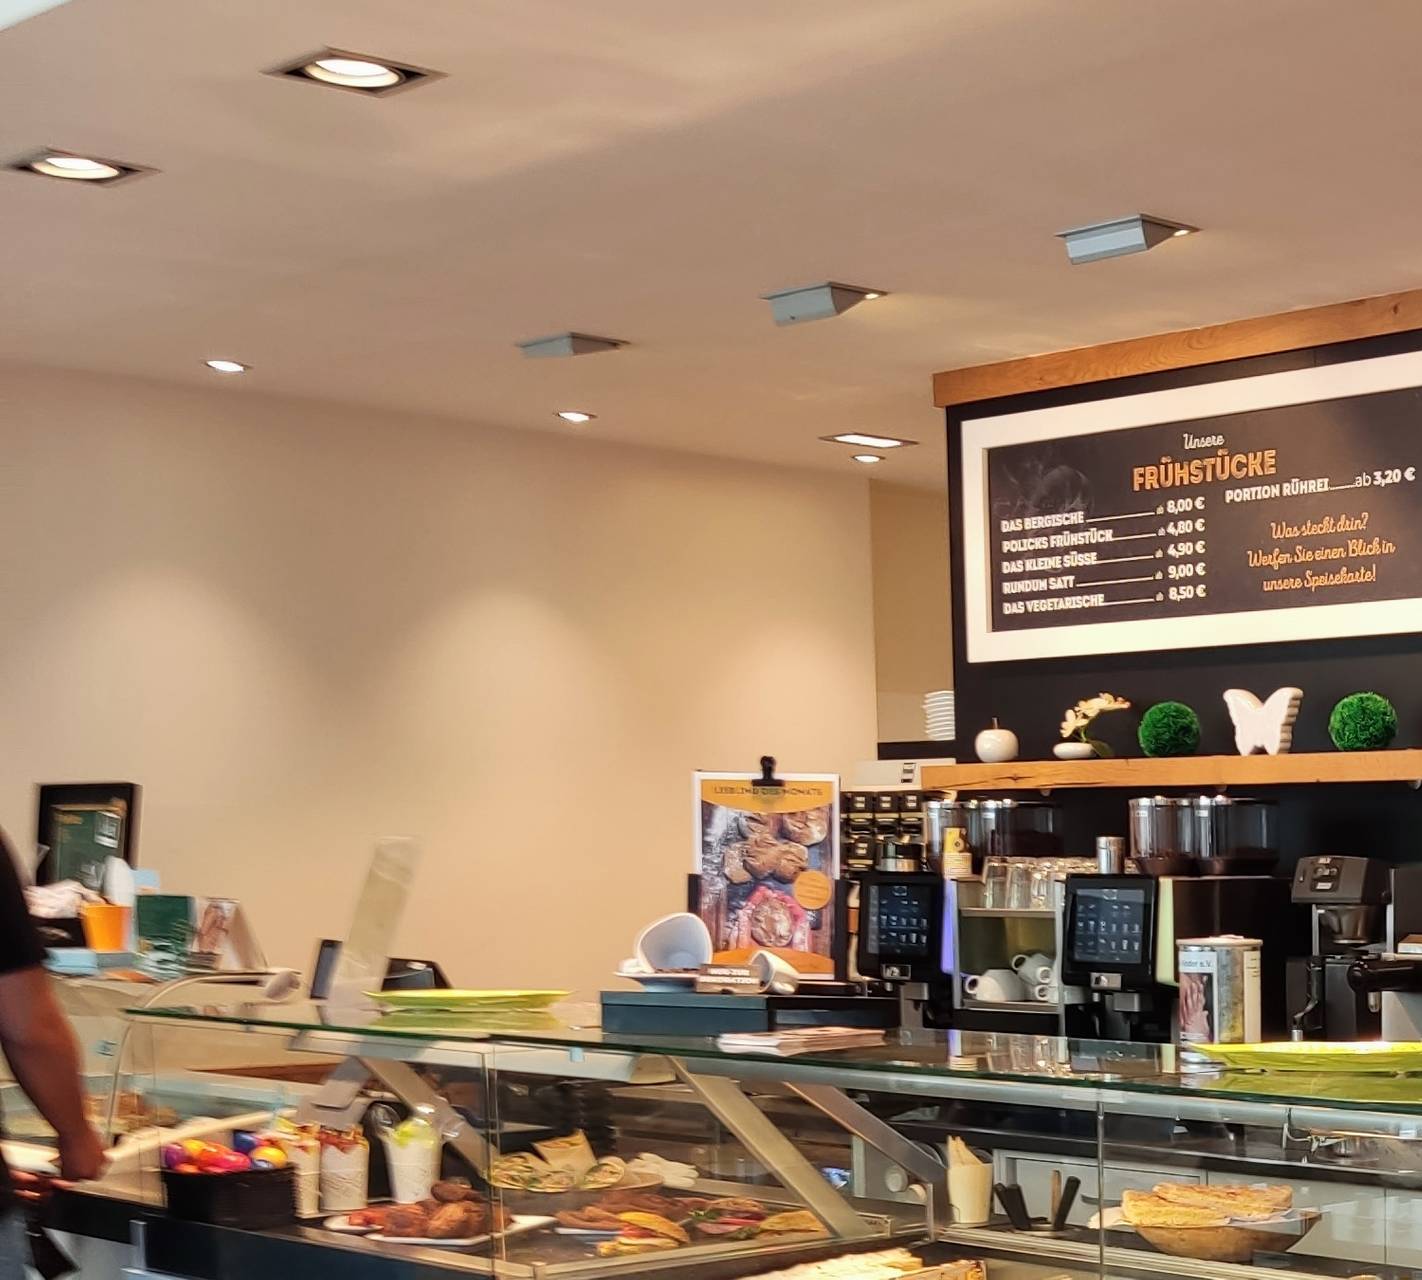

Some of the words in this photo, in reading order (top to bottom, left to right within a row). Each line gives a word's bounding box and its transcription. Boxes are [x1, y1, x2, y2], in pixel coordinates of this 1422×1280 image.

[1183, 433, 1224, 450] Unsere
[1132, 448, 1277, 491] FRÜHSTÜCKE
[1225, 484, 1280, 503] PORTION
[1282, 478, 1330, 496] RÜHREI
[1355, 472, 1371, 487] ab
[1373, 468, 1401, 487] 3,20
[1404, 467, 1416, 481] €
[1001, 519, 1023, 532] DAS
[1024, 511, 1084, 529] BERGISCHE
[1166, 498, 1193, 514] 8,00
[1194, 497, 1205, 510] €
[1271, 521, 1300, 539] Was
[1301, 515, 1335, 536] steckt
[1336, 512, 1369, 533] drin?
[1002, 537, 1049, 553] POLICKS
[1050, 528, 1113, 548] FRÜHSTÜCK
[1166, 520, 1193, 537] 4,80
[1195, 518, 1205, 532] €
[1002, 560, 1023, 574] DAS
[1025, 556, 1062, 571] KLEINE
[1063, 551, 1098, 567] SÜSSE
[1167, 542, 1193, 559] 4,90
[1195, 540, 1206, 554] €
[1248, 550, 1293, 570] Werfen
[1294, 545, 1314, 563] Sie
[1315, 546, 1346, 561] einen
[1347, 537, 1382, 558] Blick
[1382, 539, 1396, 555] in
[1002, 579, 1048, 594] RUNDUM
[1049, 575, 1075, 590] SATT
[1167, 563, 1194, 580] 9,00
[1195, 562, 1206, 576] €
[1263, 575, 1302, 591] unsere
[1304, 563, 1377, 592] Speisekarte!
[1003, 602, 1025, 615] DAS
[1026, 594, 1104, 613] VEGETARISCHE
[1168, 585, 1194, 602] 8,50
[1196, 584, 1206, 597] €
